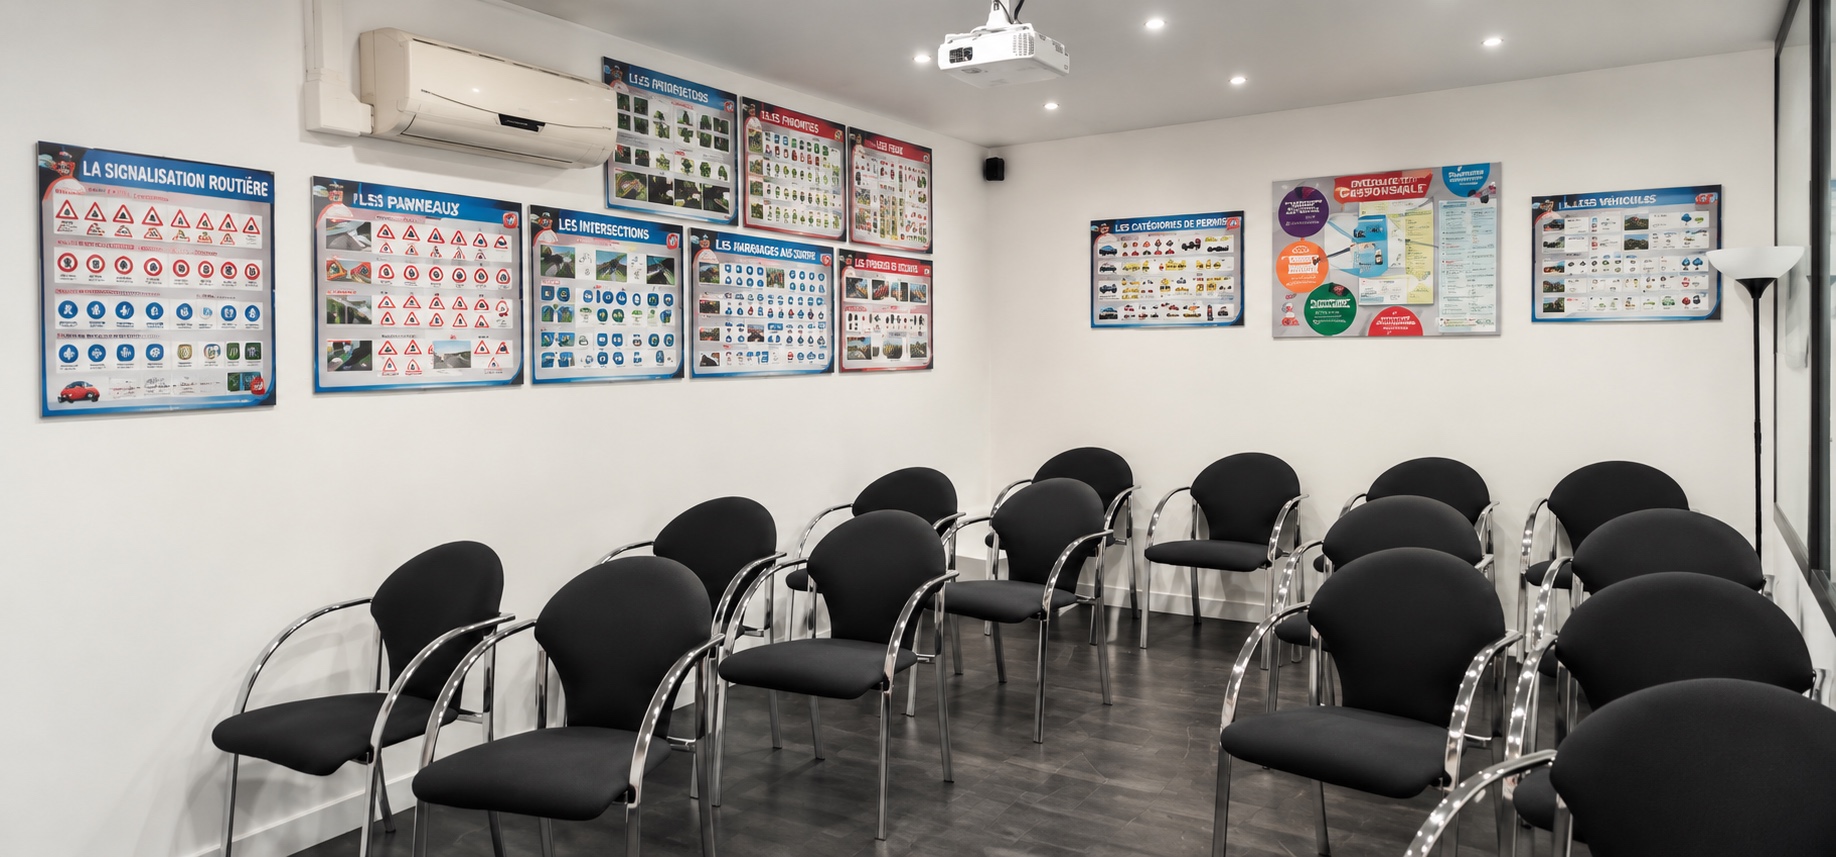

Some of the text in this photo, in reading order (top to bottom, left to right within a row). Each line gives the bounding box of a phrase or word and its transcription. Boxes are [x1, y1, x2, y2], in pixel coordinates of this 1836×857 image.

[82, 160, 101, 177] LA
[105, 162, 206, 189] SIGNALISATION
[387, 195, 460, 217] PANNEAUX
[558, 218, 650, 240] LES INTERSECTIONS
[1183, 219, 1195, 228] DE
